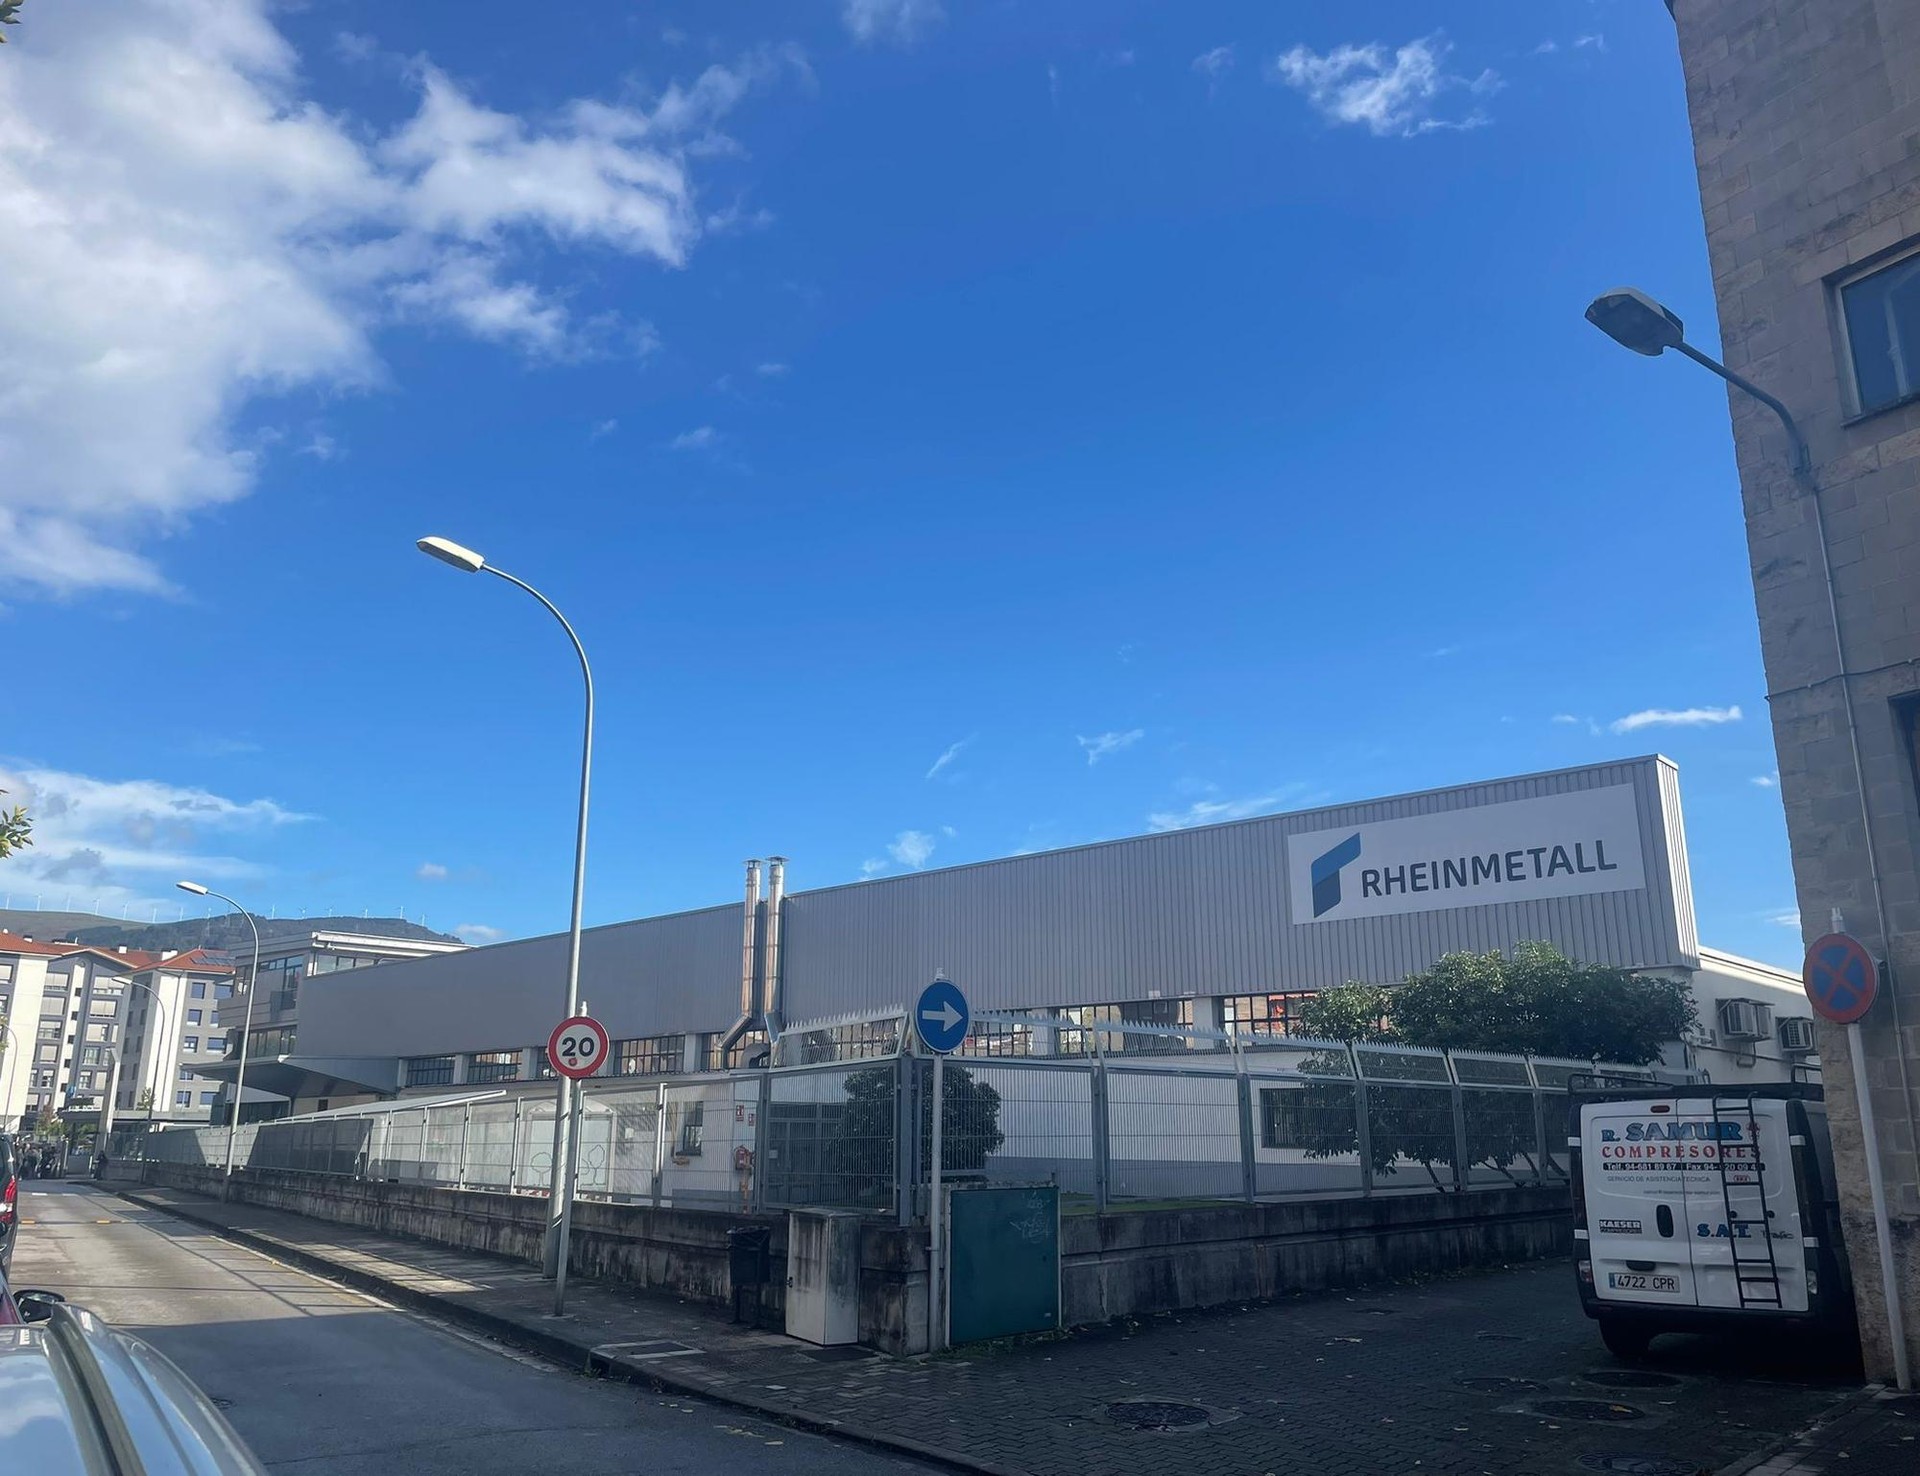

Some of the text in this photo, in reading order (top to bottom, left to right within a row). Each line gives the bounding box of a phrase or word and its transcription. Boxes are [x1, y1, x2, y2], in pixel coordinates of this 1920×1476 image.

[1361, 840, 1618, 898] RHEINMETALL
[562, 1036, 595, 1057] 20
[1601, 1122, 1743, 1142] R. SAMUR
[1602, 1145, 1761, 1158] COMPRESORES
[1617, 1275, 1675, 1290] 4722 CPR
